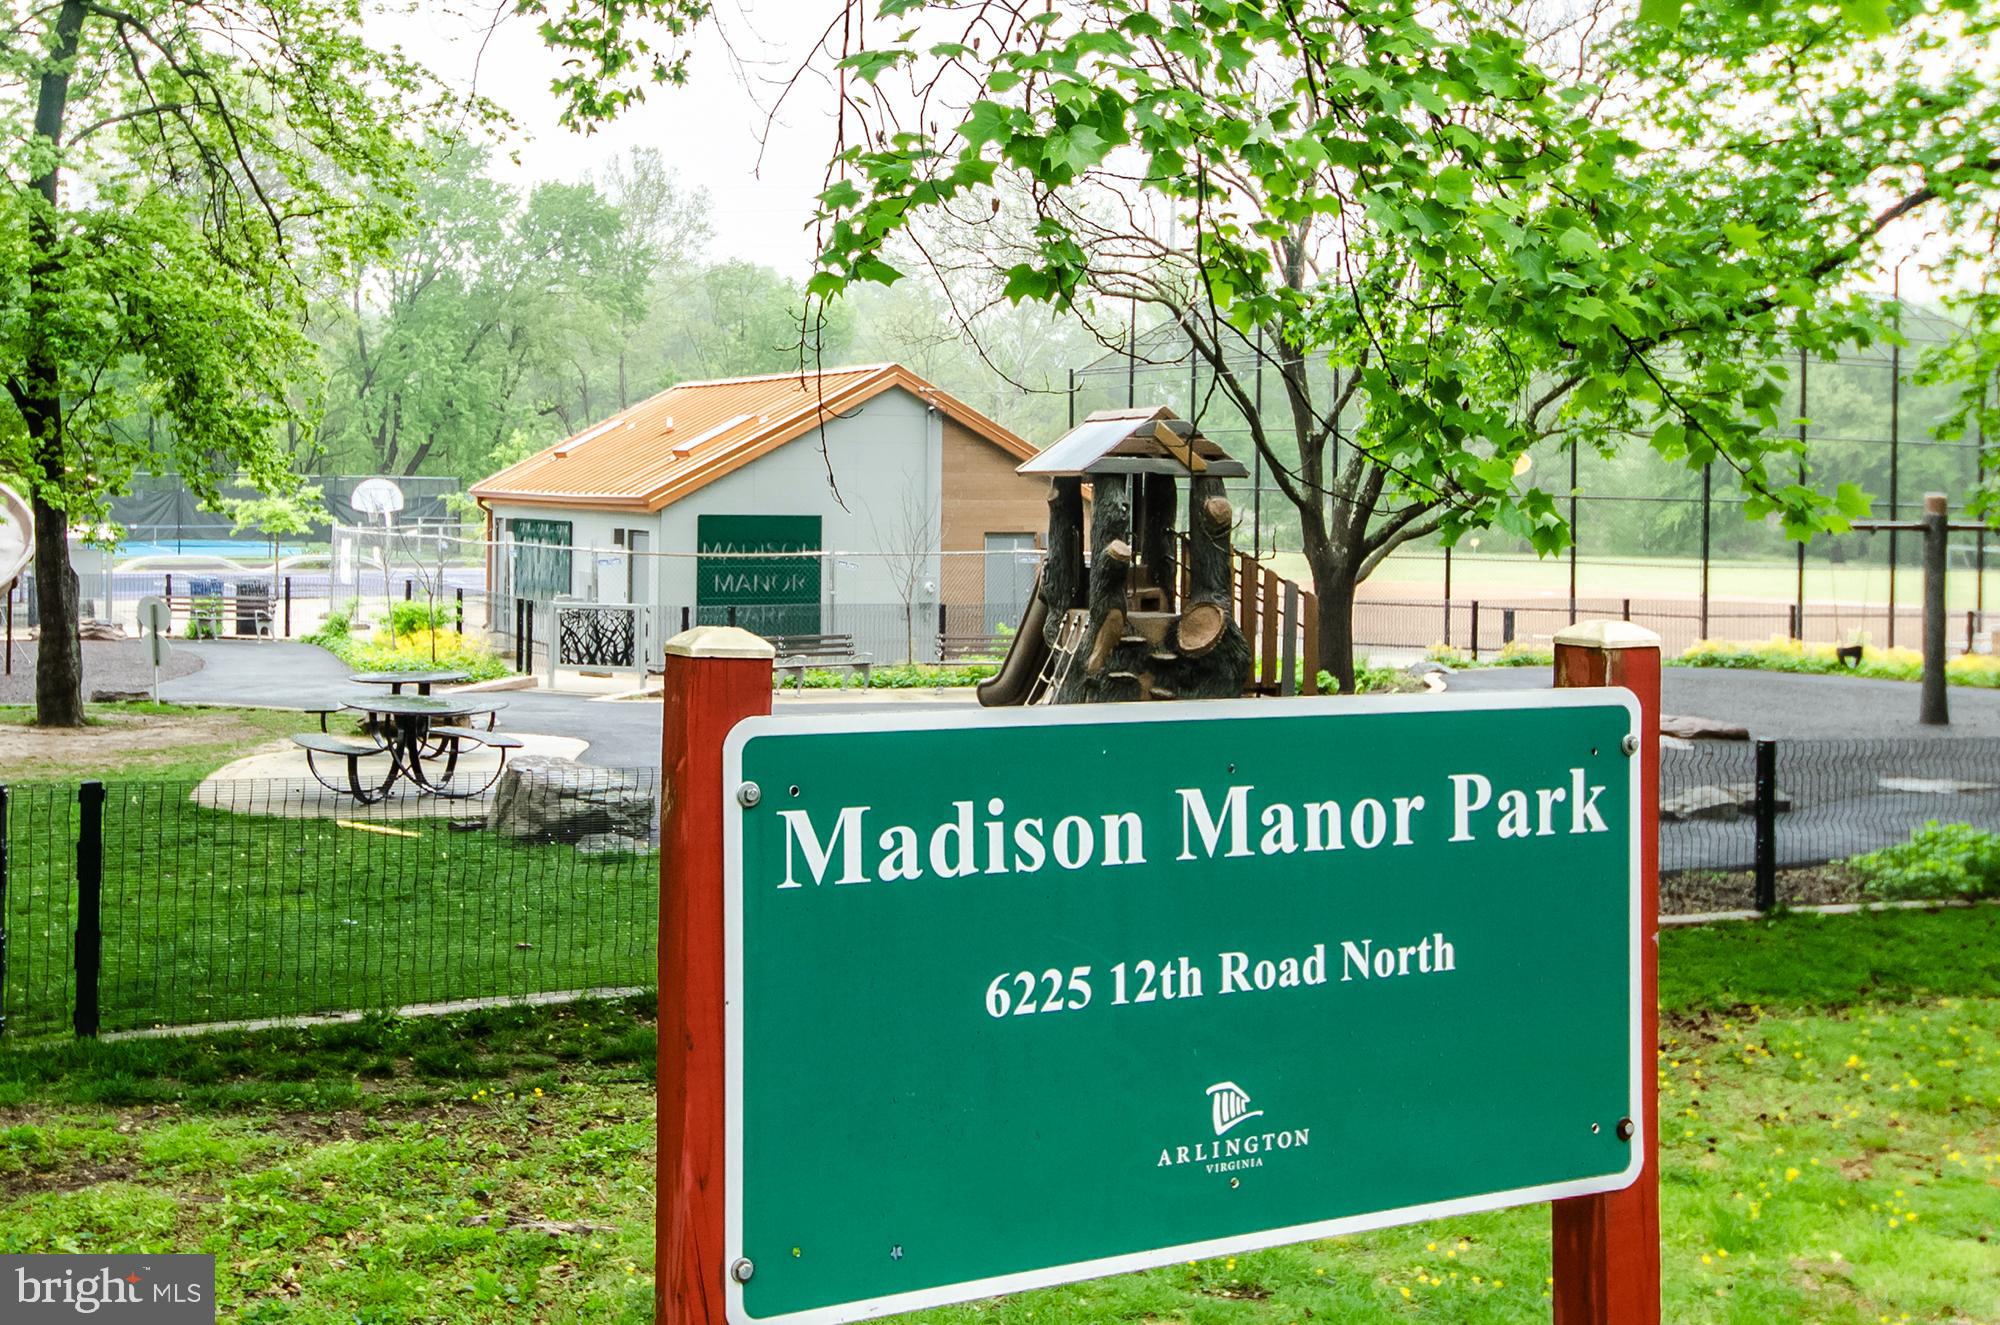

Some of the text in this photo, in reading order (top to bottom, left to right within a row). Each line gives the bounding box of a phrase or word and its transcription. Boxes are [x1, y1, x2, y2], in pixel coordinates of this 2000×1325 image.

[776, 768, 1609, 889] Madison Manor Park
[985, 933, 1456, 1018] 6225 12th Road North
[1157, 1128, 1310, 1167] ARLINGTON
[1206, 1158, 1263, 1174] VIRGINIA
